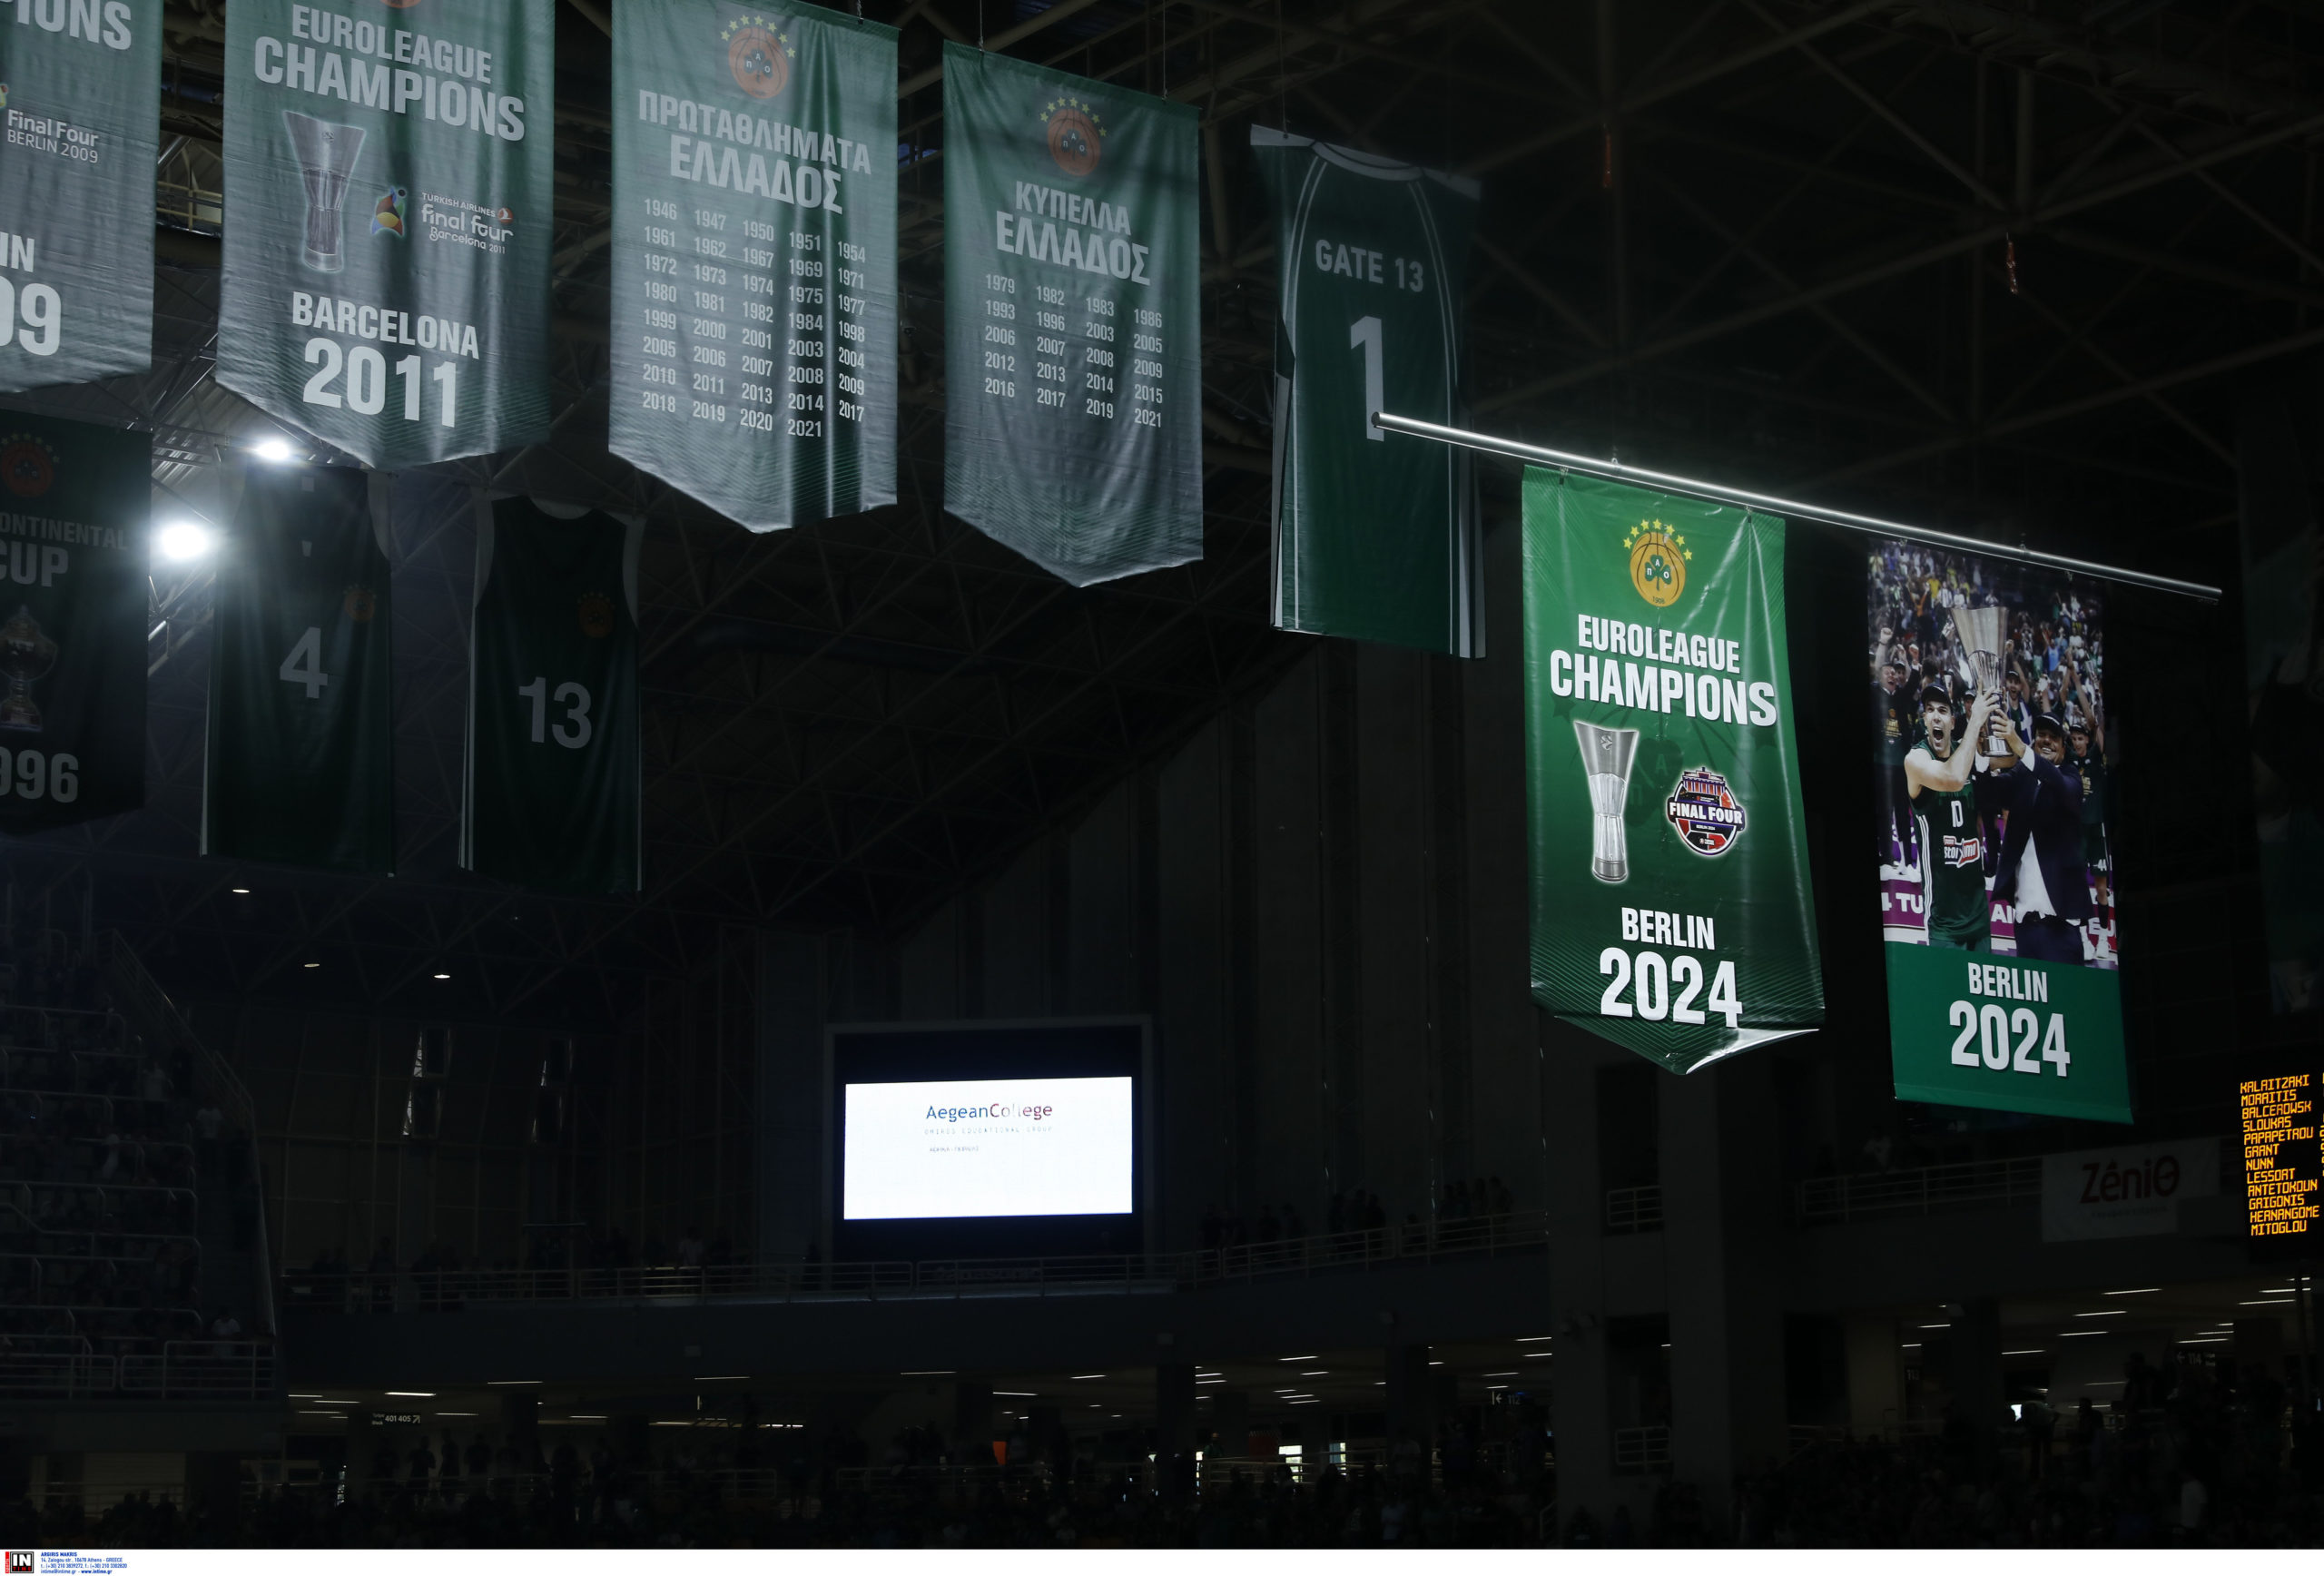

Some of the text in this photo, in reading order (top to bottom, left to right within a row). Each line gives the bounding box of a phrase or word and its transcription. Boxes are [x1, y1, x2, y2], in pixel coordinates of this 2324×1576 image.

[0, 0, 132, 50] IONS
[292, 5, 492, 85] EUROLEAGUE
[254, 36, 526, 142] CHAMPIONS
[7, 109, 99, 147] Final Four
[7, 128, 98, 164] BERLIN 2009
[639, 89, 872, 175] ΠΡΩΤΑΘΛΗΜΑΤΑ
[671, 134, 842, 215] ΕΛΛΑΔΟΣ
[421, 203, 514, 242] final four
[422, 192, 497, 218] TURKISH AIRLINES
[645, 198, 865, 263] 1946 1947 1950 1951 1954
[1016, 181, 1131, 236] ΚΥΠΕΛΛΑ
[429, 226, 506, 254] Barcelona 2011
[645, 225, 864, 290] 1961 1962 1967 1969 1971
[997, 210, 1150, 286] ΕΛΛΑΔΟΣ
[1315, 239, 1424, 293] GATE 13
[645, 253, 866, 316] 1972 1973 1974 1975 1977
[986, 274, 1162, 329] 1979 1982 1983 1986
[292, 291, 479, 360] BARCELONA
[644, 281, 865, 342] 1980 1981 1982 1984 1998
[986, 300, 1162, 354] 1993 1996 2003 2005
[644, 309, 865, 369] 1999 2000 2001 2003 2004
[985, 325, 1162, 379] 2006 2007 2008 2009
[302, 337, 457, 428] 2011
[643, 336, 865, 396] 2005 2006 2007 2008 2009
[643, 363, 864, 422] 2010 2011 2013 2014 2017
[985, 351, 1163, 404] 2012 2013 2014 2015
[1350, 315, 1385, 442] 1
[643, 391, 822, 438] 2018 2019 2020 2021
[985, 377, 1161, 428] 2016 2017 2019 2021
[279, 625, 329, 699] 4
[1577, 615, 1740, 674] EUROLEAGUE
[517, 676, 592, 750] 13
[1550, 649, 1777, 727] CHAMPIONS
[1669, 802, 1743, 824] FINAL FOUR
[1621, 907, 1715, 951] BERLIN
[1991, 903, 2015, 924] AI
[1599, 947, 1743, 1029] 2024
[1967, 961, 2048, 1004] BERLIN
[1949, 1000, 2071, 1078] 2024
[2240, 1074, 2309, 1094] KALAITZAKI
[2240, 1088, 2297, 1107] MORAITIS
[2241, 1100, 2311, 1119] BALCEROWSK
[2242, 1116, 2292, 1133] SLOUKAS
[2243, 1126, 2314, 1146] PAPAPETROU
[2245, 1143, 2280, 1158] GRANT
[2246, 1157, 2274, 1171] NUNN
[2247, 1167, 2296, 1185] LESSORT
[2248, 1178, 2318, 1197] ANTETOKOUN
[2249, 1193, 2305, 1210] GRIGONIS
[2250, 1205, 2320, 1224] HERNANGOME
[2250, 1220, 2307, 1236] MITOGLOU
[385, 1414, 397, 1423] 401
[398, 1414, 411, 1423] 405
